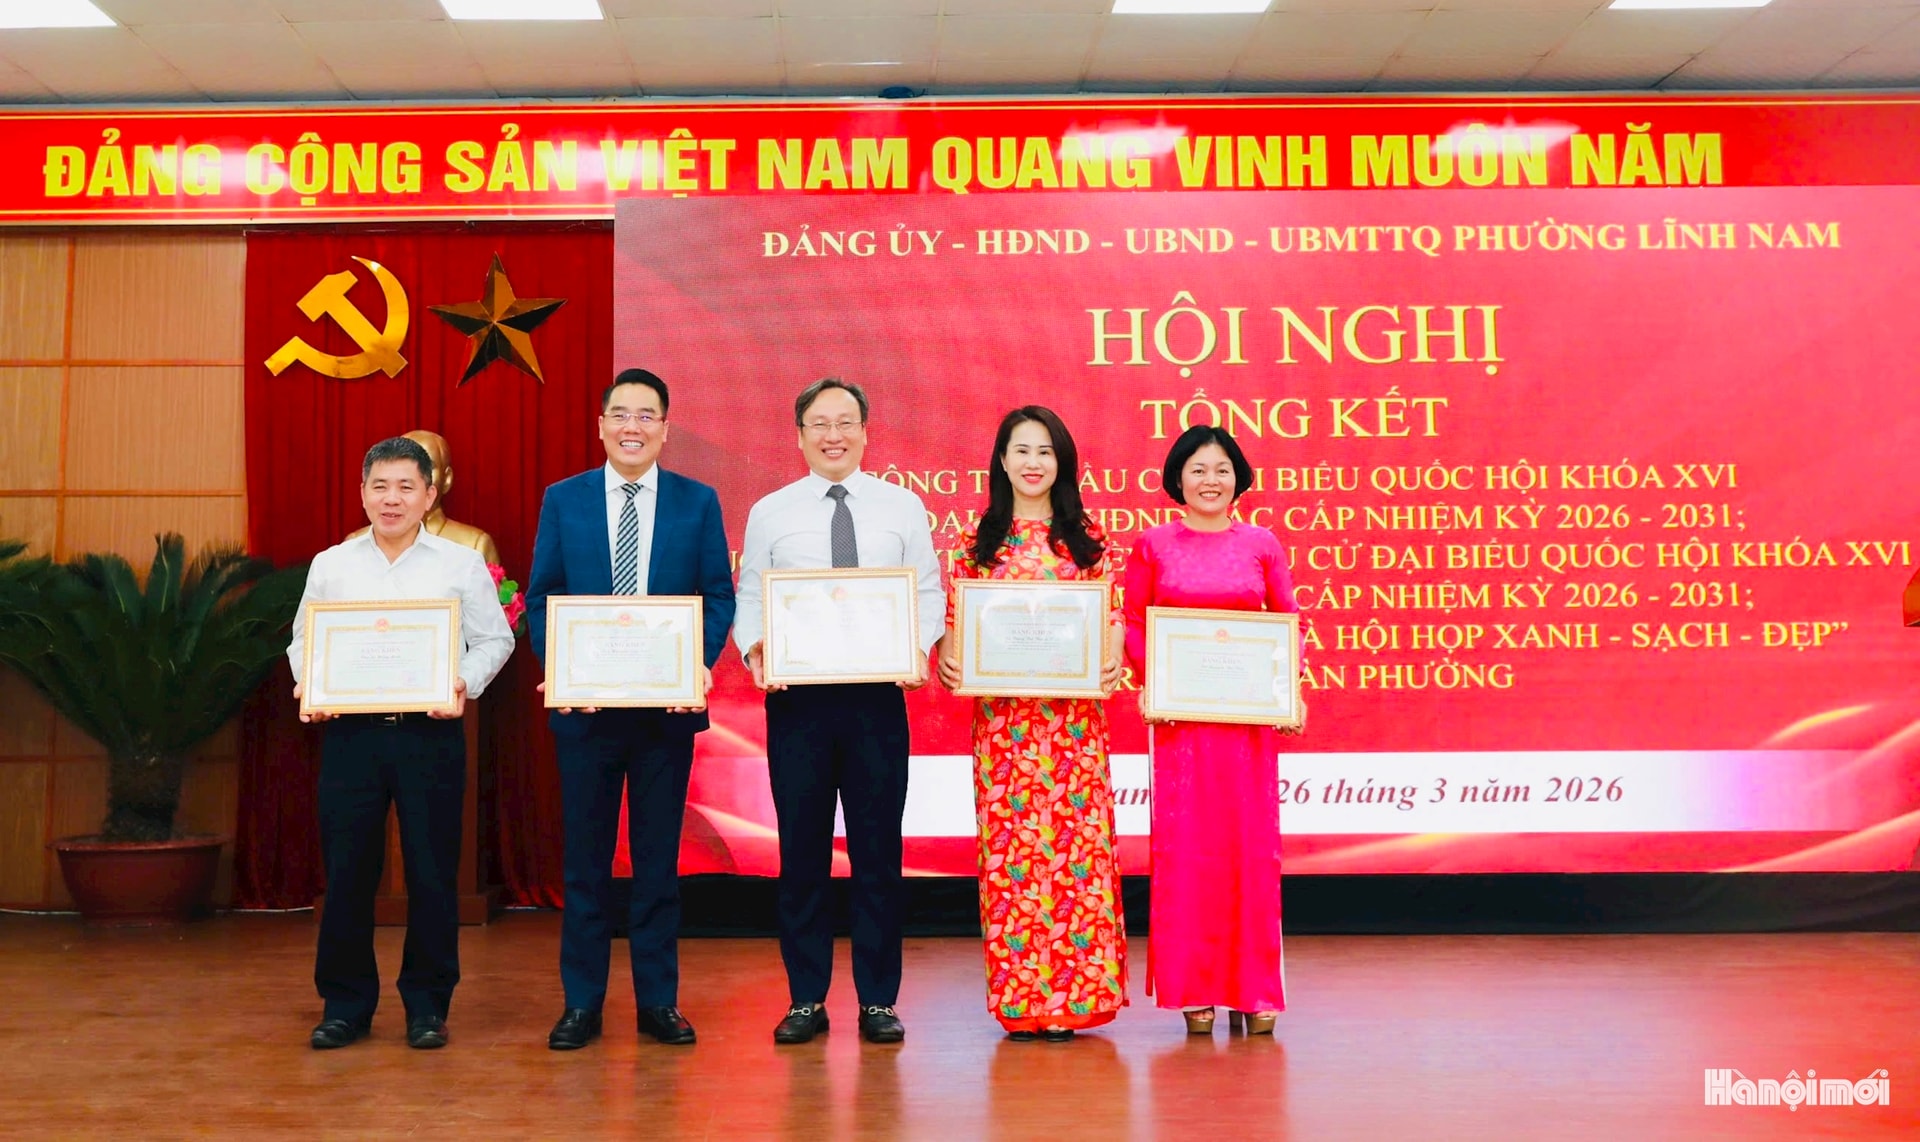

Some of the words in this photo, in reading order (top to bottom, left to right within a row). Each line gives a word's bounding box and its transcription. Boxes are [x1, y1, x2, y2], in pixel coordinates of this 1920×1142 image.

[43, 128, 221, 196] ĐẢNG
[245, 132, 421, 205] CỘNG
[445, 124, 577, 192] SẢN
[600, 128, 735, 198] VIỆT
[758, 138, 908, 190] NAM
[932, 137, 1152, 194] QUANG
[1174, 136, 1326, 187] VINH
[1352, 124, 1548, 187] MUÔN
[1570, 122, 1723, 186] NĂM
[761, 224, 877, 257] ĐẢNG
[888, 222, 943, 256] ỦY
[976, 229, 1091, 254] HĐND
[1125, 228, 1235, 254] UBND
[1268, 226, 1441, 258] UBMTTQ
[1453, 217, 1627, 251] PHƯỜNG
[1638, 217, 1737, 249] LĨNH
[1747, 222, 1841, 249] NAM
[1086, 291, 1249, 378] HỘI
[1272, 305, 1505, 375] NGHỊ
[1140, 387, 1312, 439] TỔNG
[1332, 385, 1448, 437] KẾT
[862, 464, 957, 495] ÔNG
[1079, 461, 1128, 493] ẦU
[1276, 460, 1360, 491] BIỂU
[1371, 458, 1473, 496] QUỐC
[1485, 459, 1548, 494] HỘI
[1560, 457, 1665, 490] KHÓA
[1674, 464, 1737, 489] XVI
[1230, 500, 1273, 530] ÁC
[1284, 499, 1355, 531] CẤP
[1363, 500, 1483, 534] NHIỆM
[1495, 497, 1546, 530] KỲ
[1557, 504, 1631, 529] 2026
[1662, 504, 1746, 532] 2031;
[1308, 539, 1364, 570] CỬ
[1370, 545, 1435, 574] ĐẠI
[1446, 537, 1531, 569] BIỂU
[1541, 536, 1645, 573] QUỐC
[1657, 536, 1720, 572] HỘI
[1732, 535, 1837, 567] KHÓA
[1846, 540, 1911, 566] XVI
[1292, 577, 1362, 610] CẤP
[1370, 579, 1491, 614] NHIỆM
[1502, 576, 1553, 608] KỲ
[1565, 583, 1639, 608] 2026
[1670, 582, 1754, 610] 2031;
[1336, 618, 1399, 654] HỘI
[1411, 623, 1485, 654] HỌP
[1494, 624, 1600, 649] XANH
[1632, 623, 1730, 652] SẠCH
[1299, 658, 1346, 690] ÀN
[1358, 656, 1514, 689] PHƯỜNG
[1278, 778, 1311, 804] 26
[1322, 778, 1418, 811] tháng
[1429, 777, 1447, 803] 3
[1459, 777, 1530, 803] năm
[1544, 776, 1624, 802] 2026
